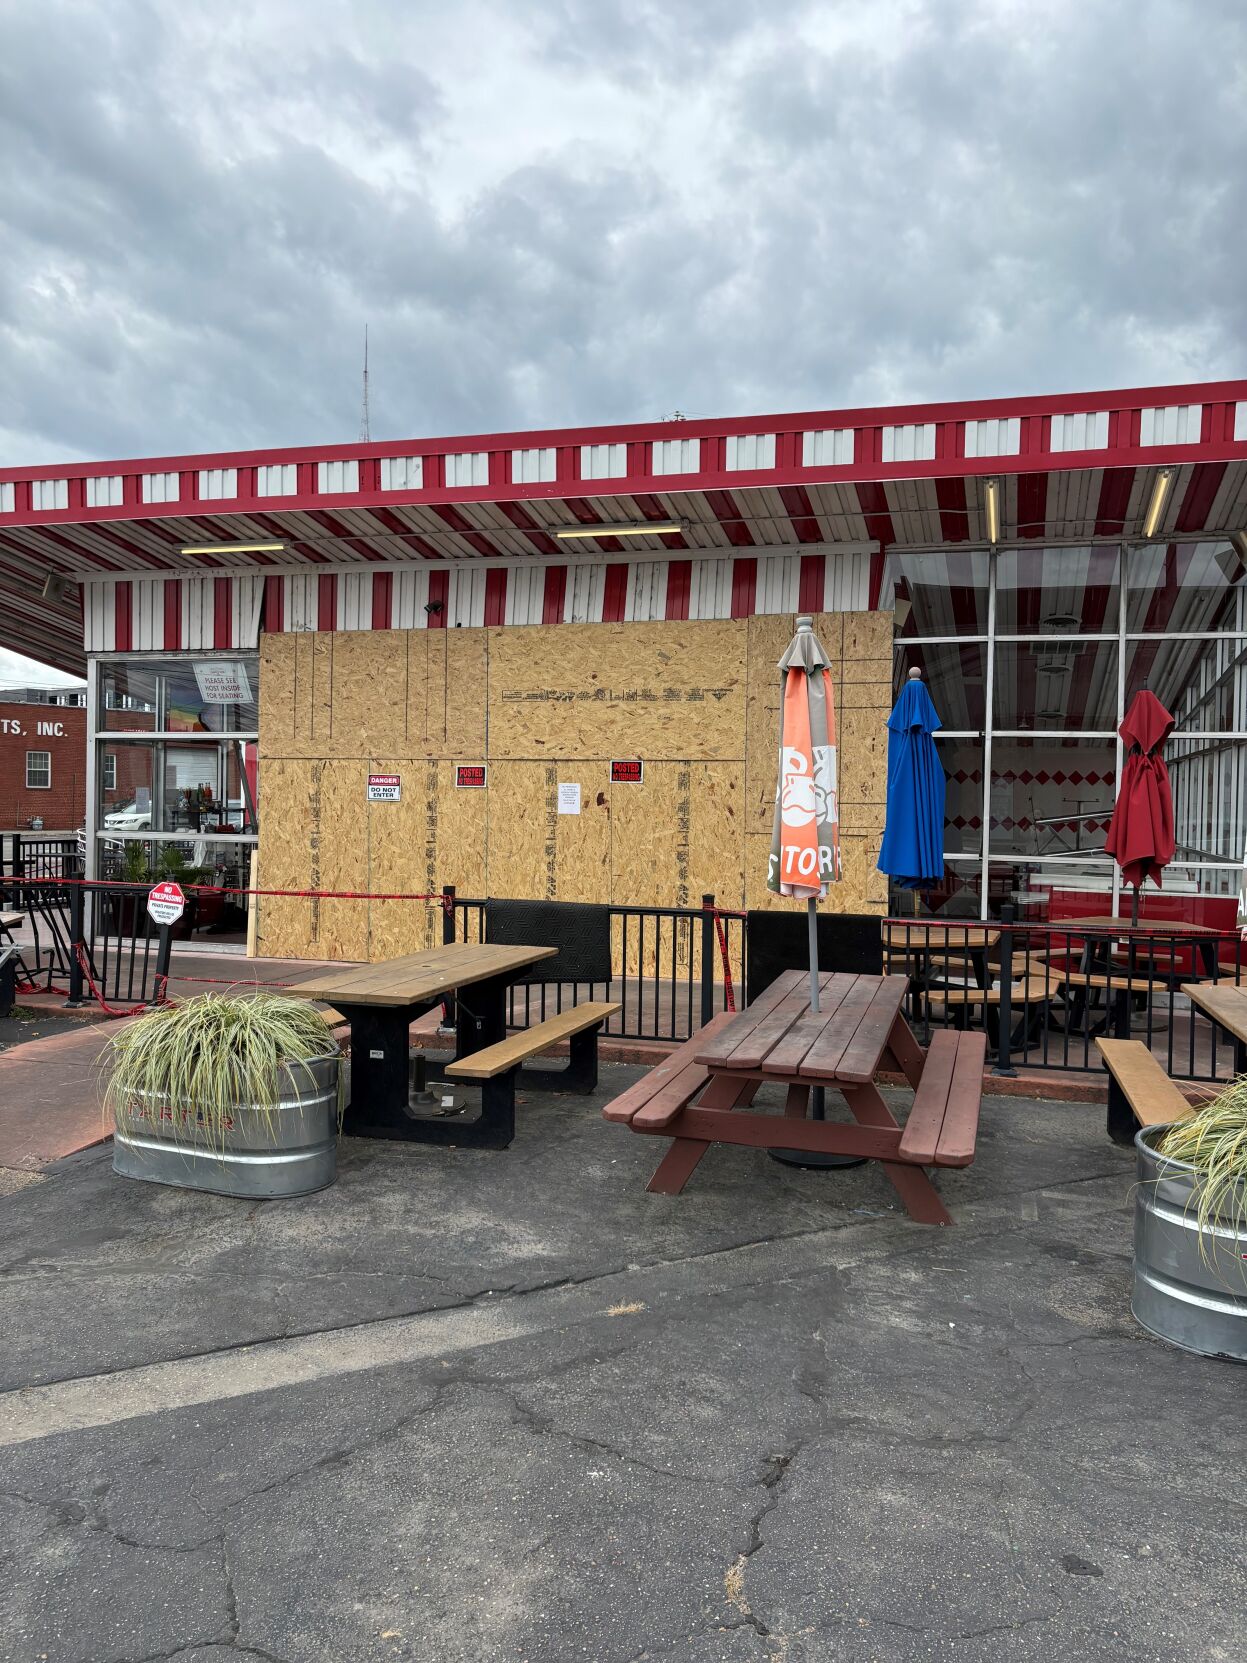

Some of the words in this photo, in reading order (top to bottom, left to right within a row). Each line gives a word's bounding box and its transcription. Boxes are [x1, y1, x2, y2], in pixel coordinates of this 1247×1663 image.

[1, 719, 28, 736] TS,
[37, 721, 68, 736] INC.
[614, 763, 639, 772] POSTED
[460, 768, 483, 777] POSTED
[152, 892, 182, 902] TRESPASSING
